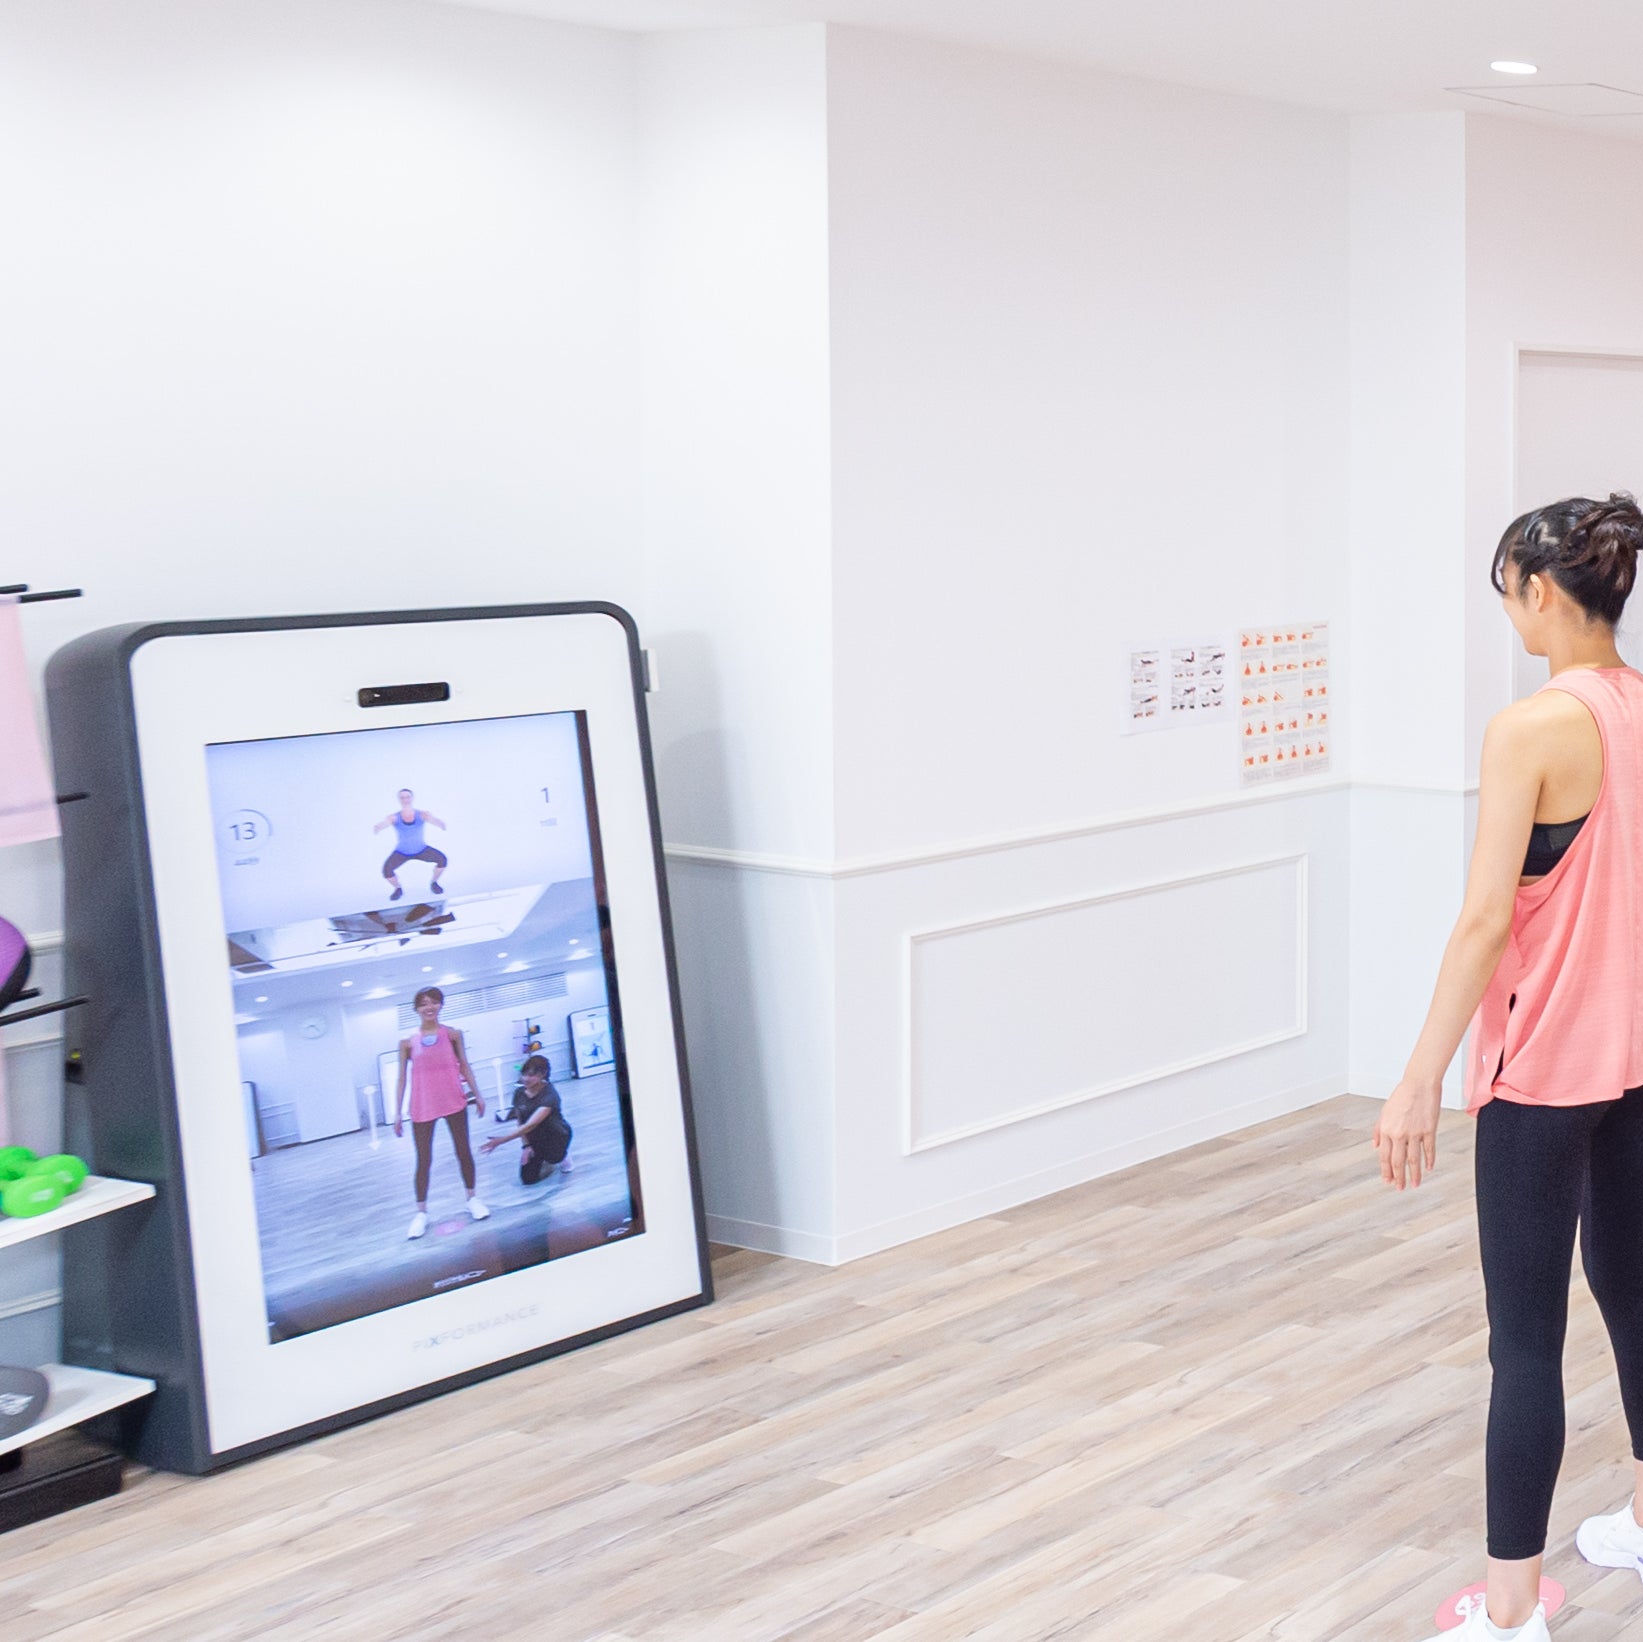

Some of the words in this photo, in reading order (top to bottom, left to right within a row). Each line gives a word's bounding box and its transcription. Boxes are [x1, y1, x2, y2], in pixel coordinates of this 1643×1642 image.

[540, 787, 549, 803] 1
[229, 822, 257, 840] 13
[412, 1304, 540, 1352] PIXFORMANCE
